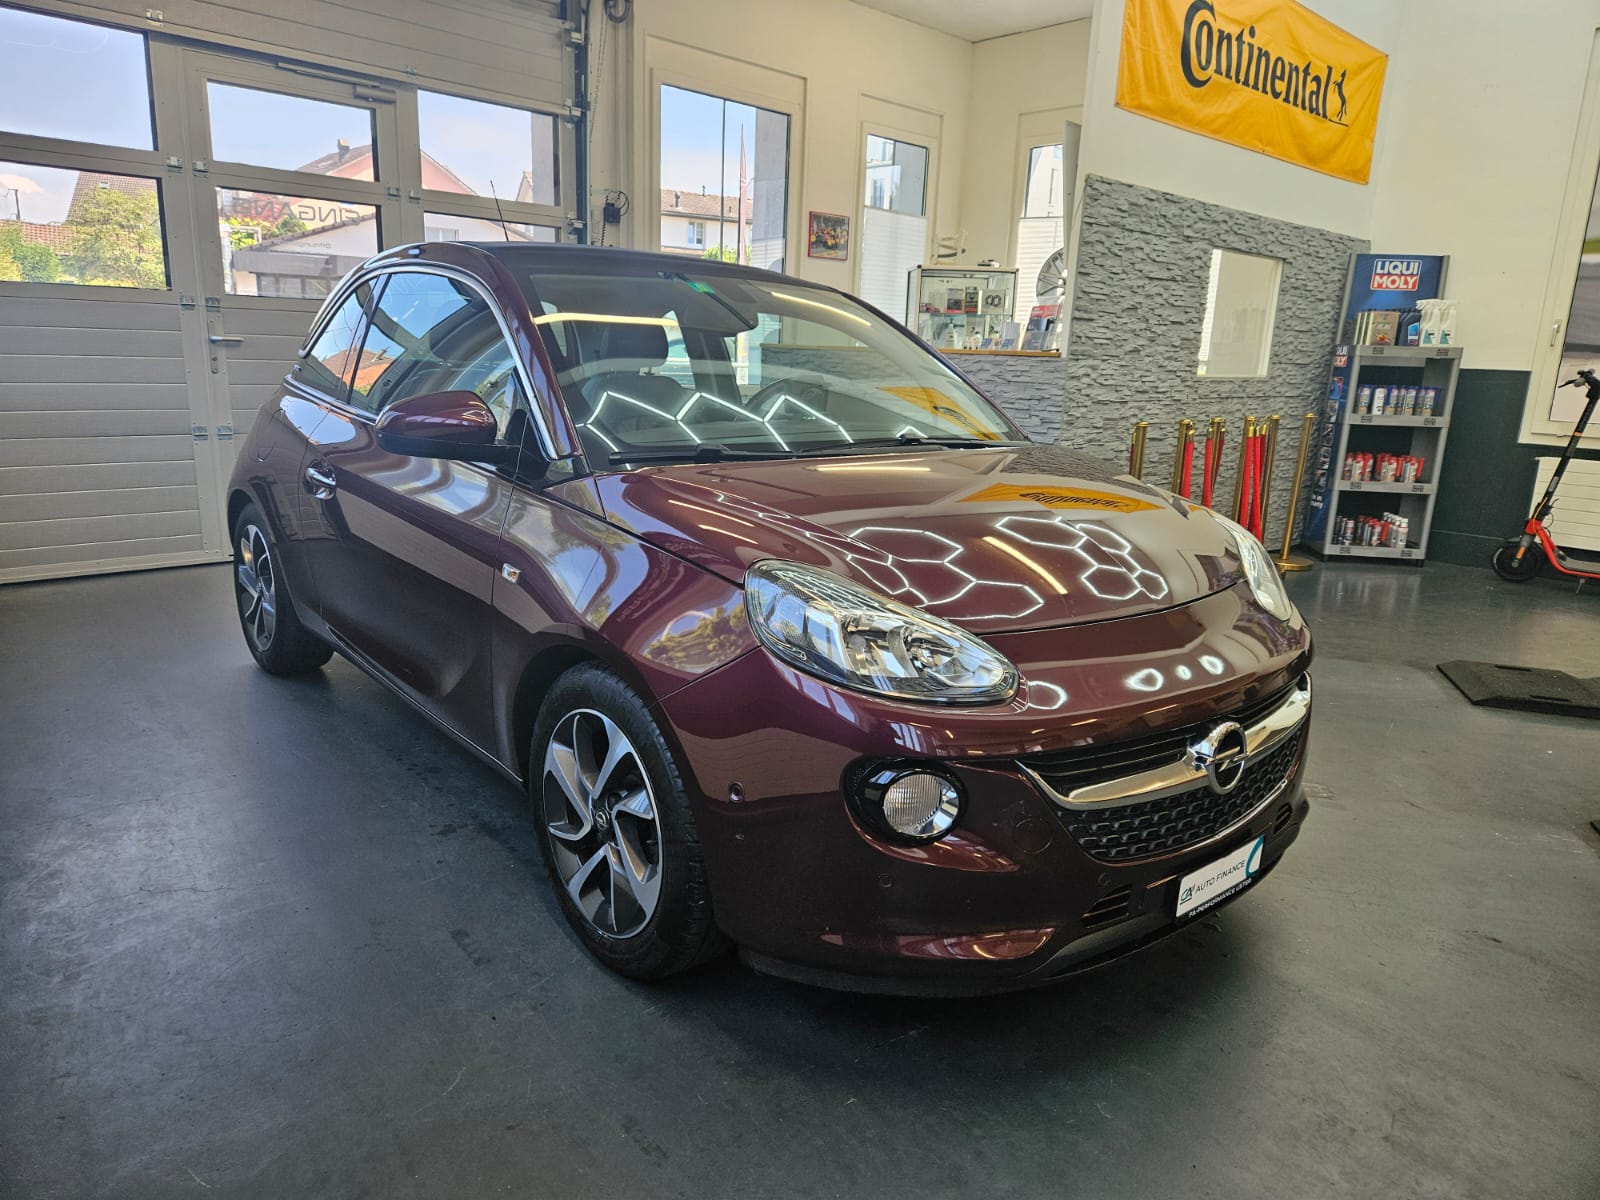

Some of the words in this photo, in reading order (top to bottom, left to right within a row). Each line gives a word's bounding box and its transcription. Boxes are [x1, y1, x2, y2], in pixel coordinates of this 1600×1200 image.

[1181, 0, 1334, 120] Continental
[1375, 261, 1420, 275] LIQUI
[1373, 275, 1418, 289] MOLY
[1195, 877, 1215, 894] AUTO
[1216, 860, 1246, 881] FINANCE
